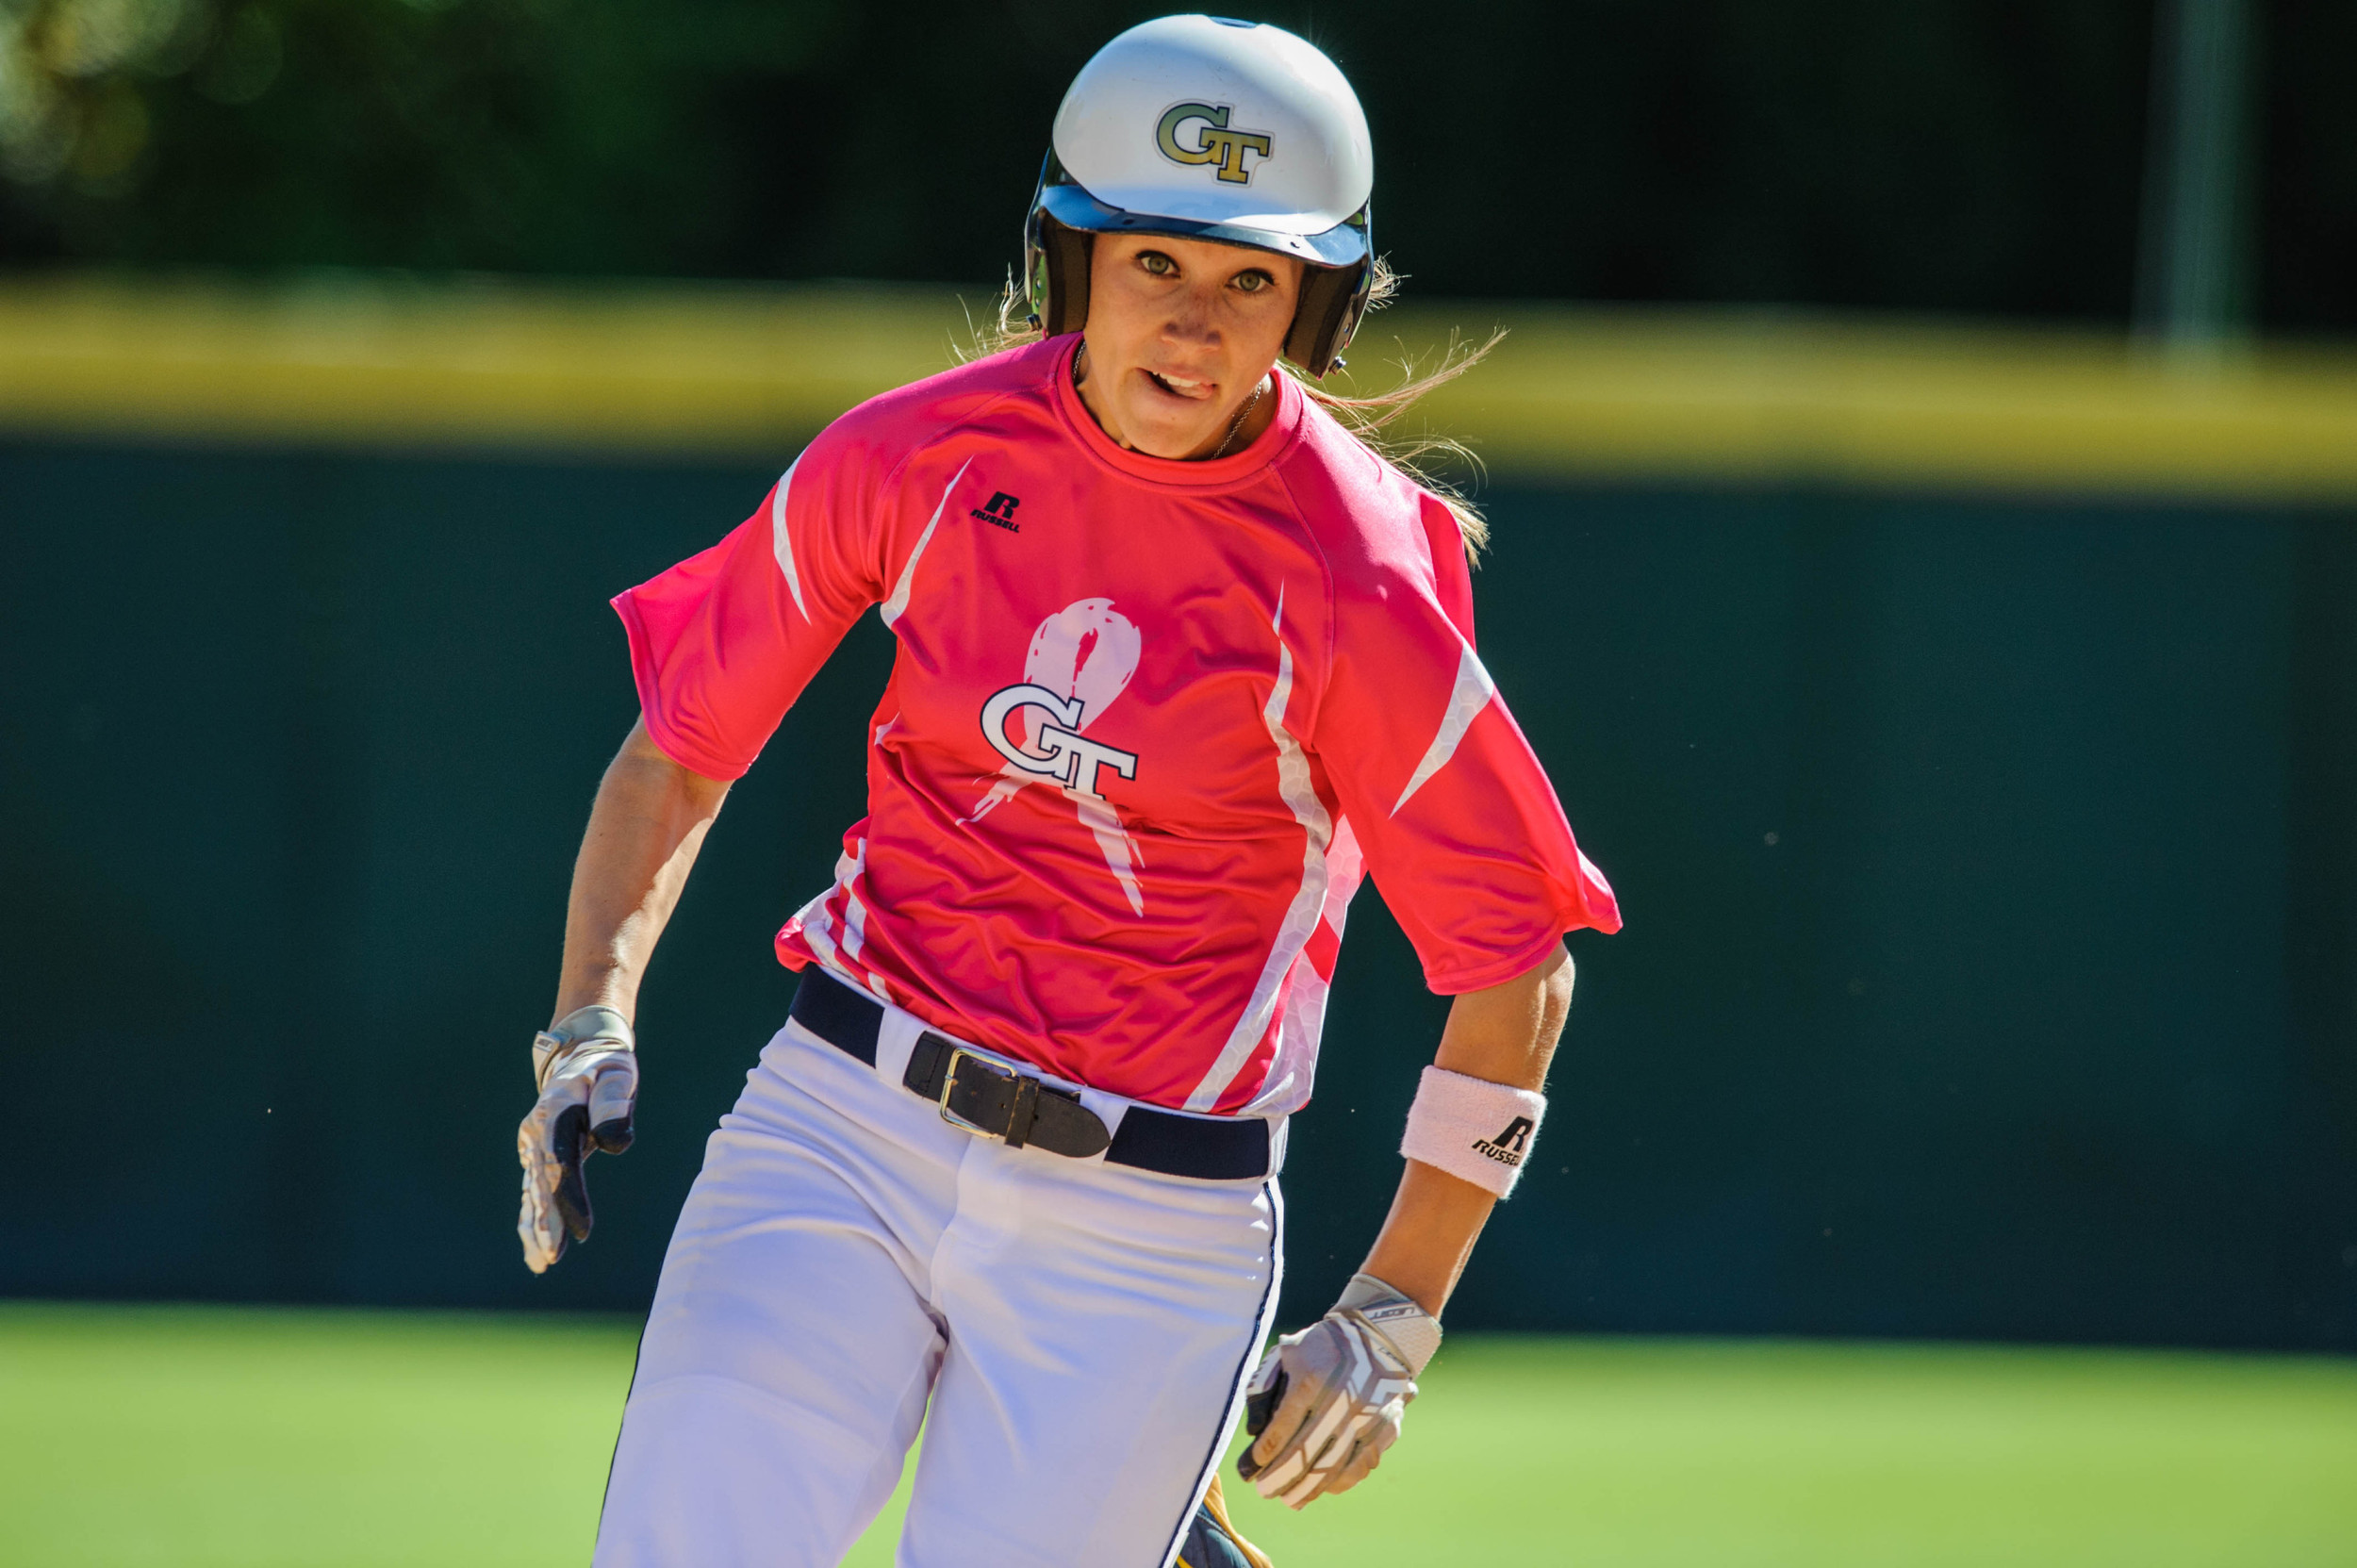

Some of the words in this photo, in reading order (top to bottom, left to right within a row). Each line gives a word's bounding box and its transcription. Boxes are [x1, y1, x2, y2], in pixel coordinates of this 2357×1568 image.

[1157, 103, 1271, 184] GT
[970, 509, 1019, 533] RUSSELL
[983, 491, 1020, 520] R
[980, 683, 1139, 801] GT
